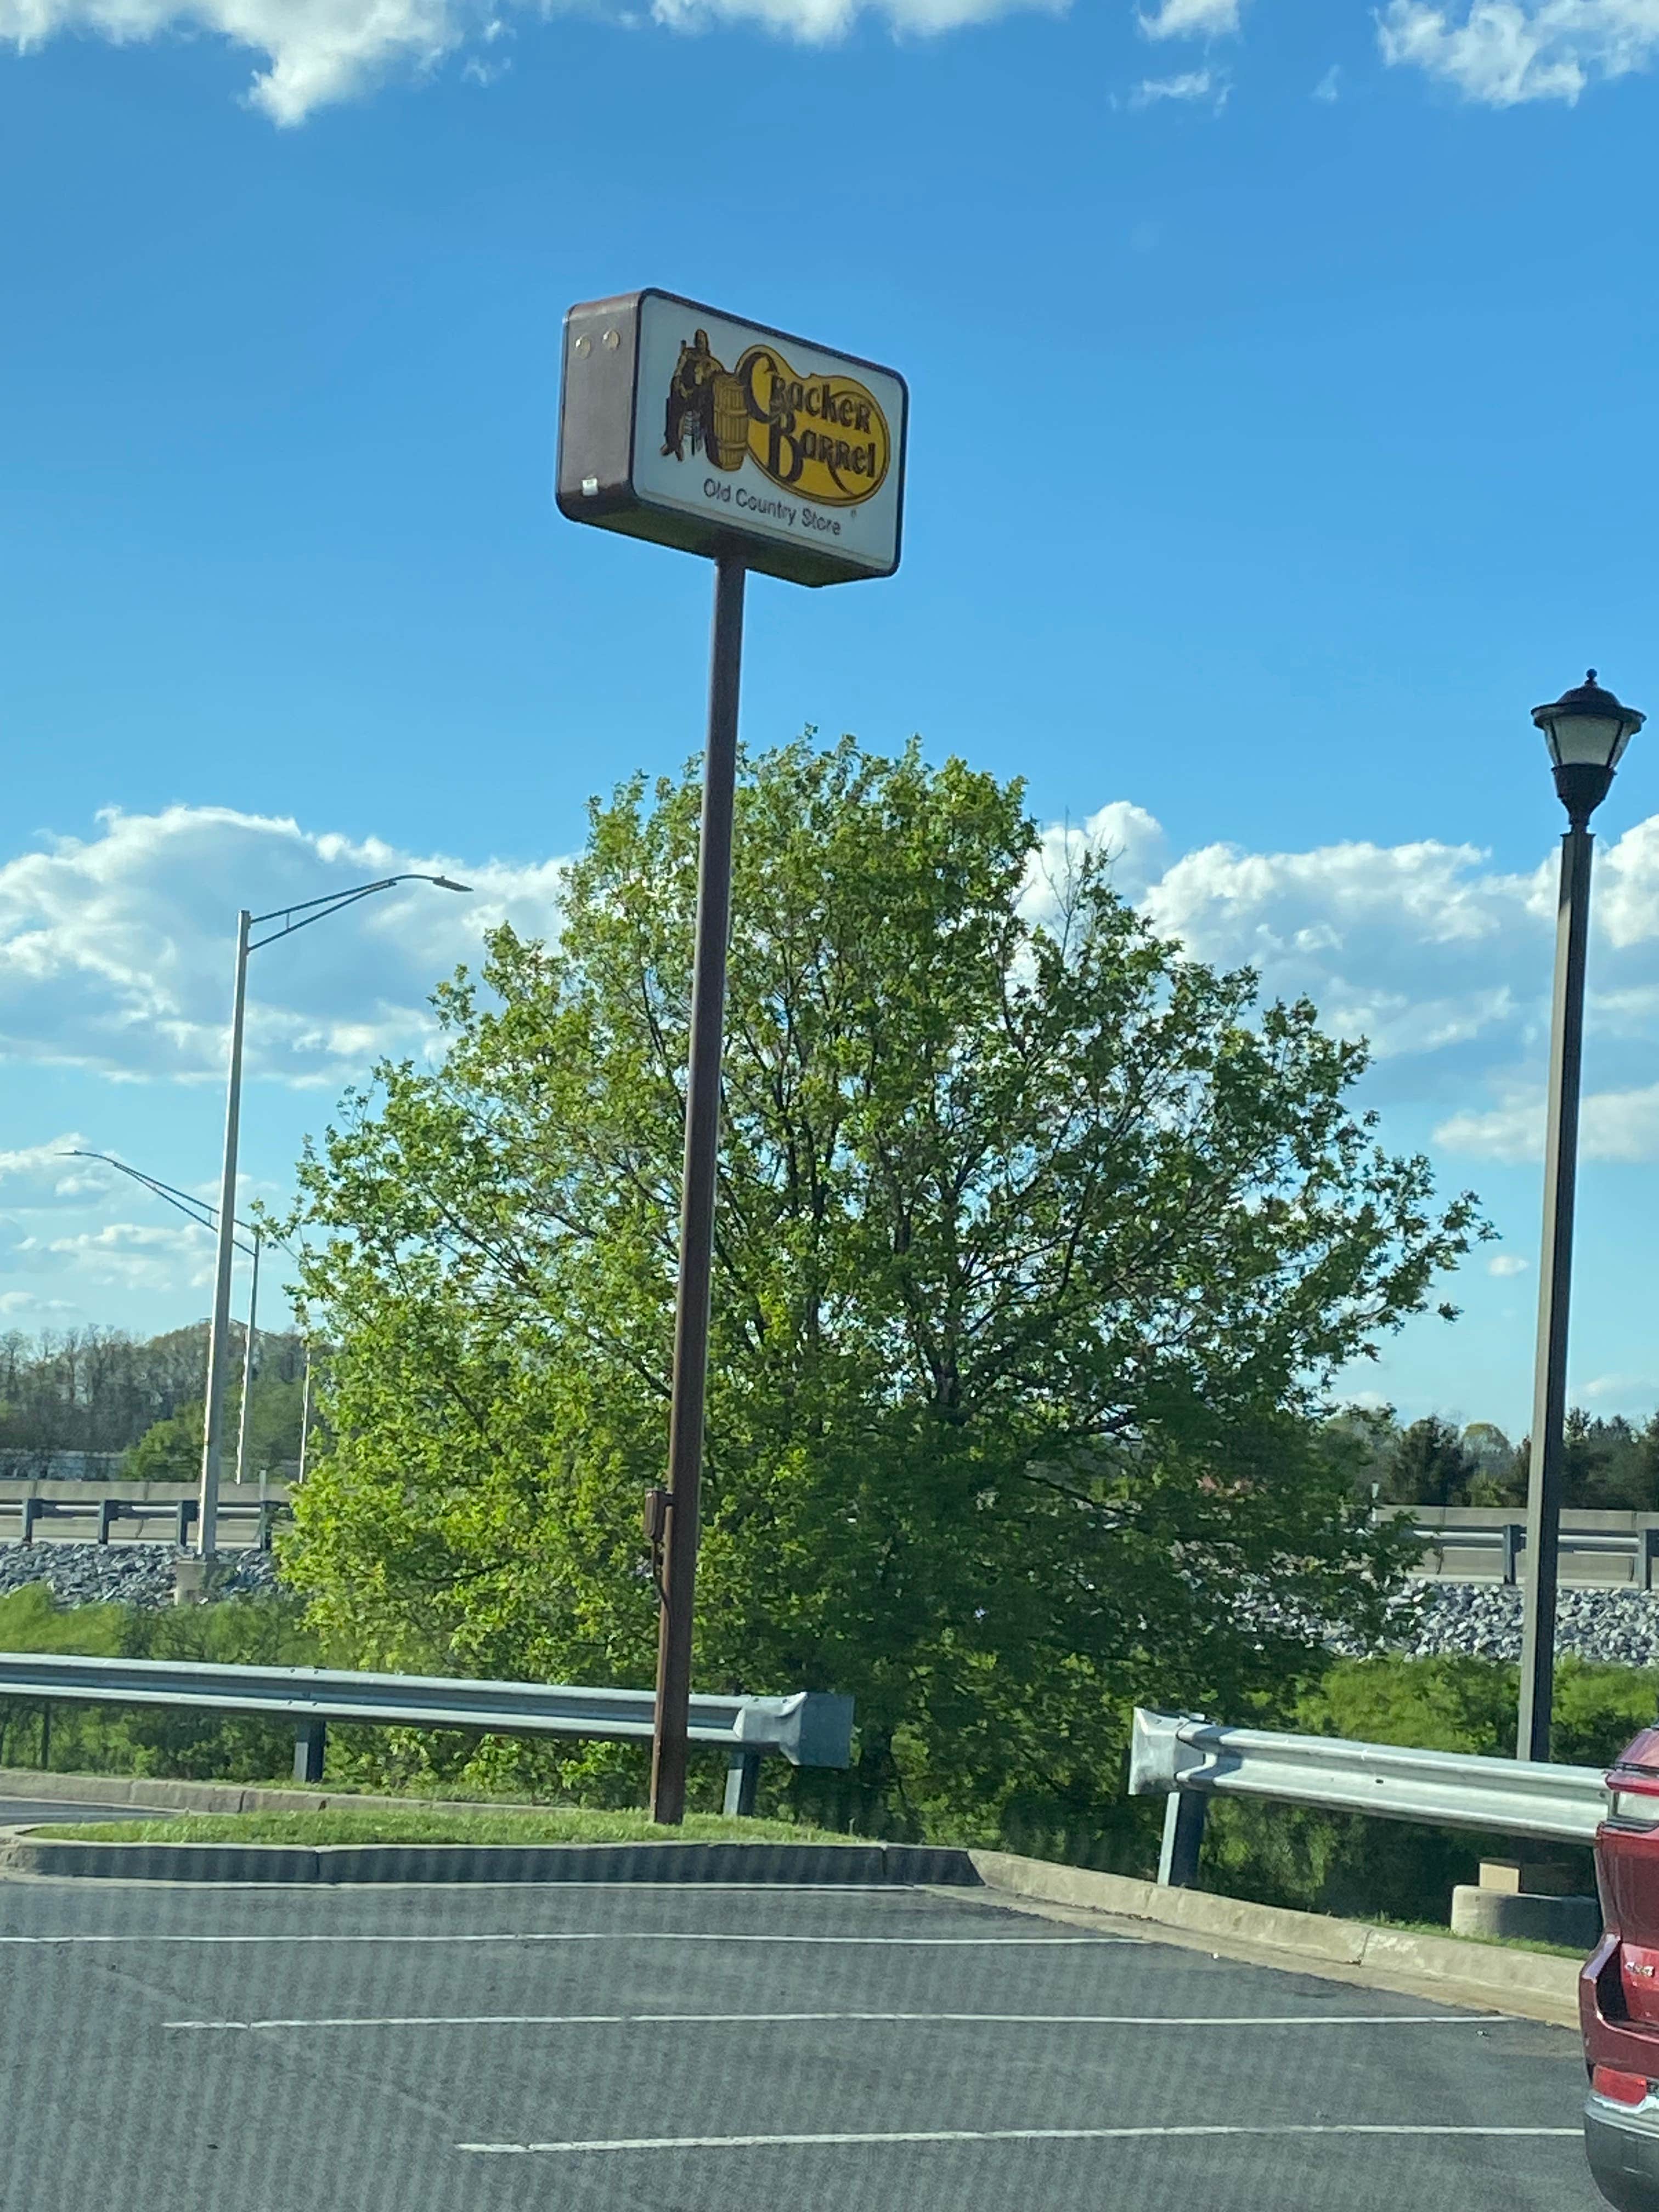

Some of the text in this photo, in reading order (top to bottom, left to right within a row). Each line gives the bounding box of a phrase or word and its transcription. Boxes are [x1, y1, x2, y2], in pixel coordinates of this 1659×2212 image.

[738, 351, 872, 435] Cracker
[768, 411, 876, 483] Barrel
[703, 478, 841, 535] Old Country Store
